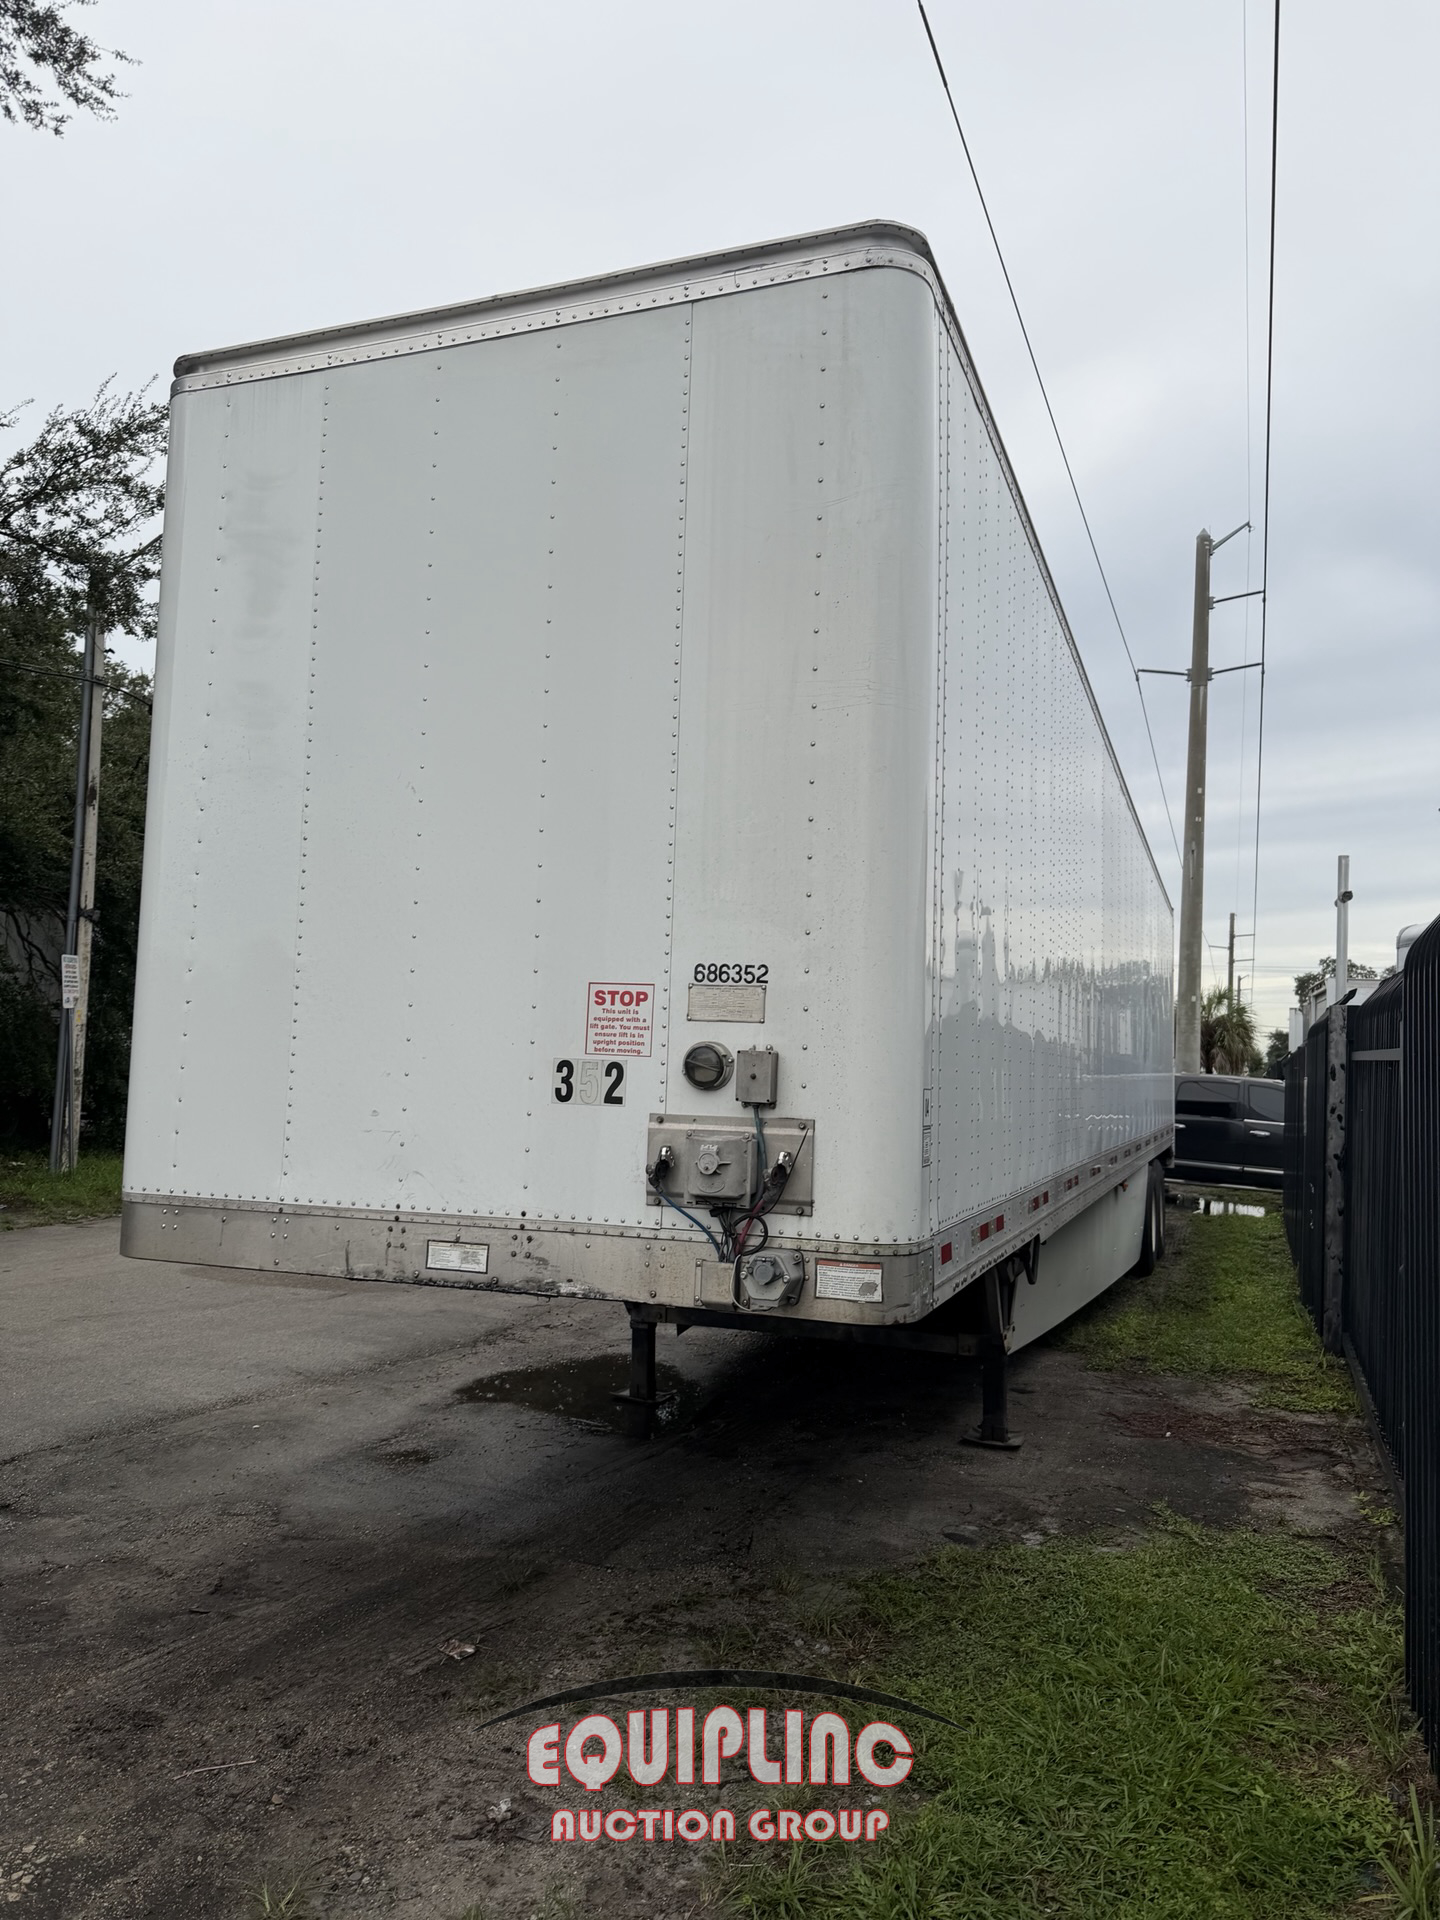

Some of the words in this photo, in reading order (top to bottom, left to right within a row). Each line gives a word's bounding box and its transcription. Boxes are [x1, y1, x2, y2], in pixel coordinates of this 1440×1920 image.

[694, 963, 769, 984] 686352
[594, 990, 649, 1007] STOP
[554, 1059, 625, 1105] 352
